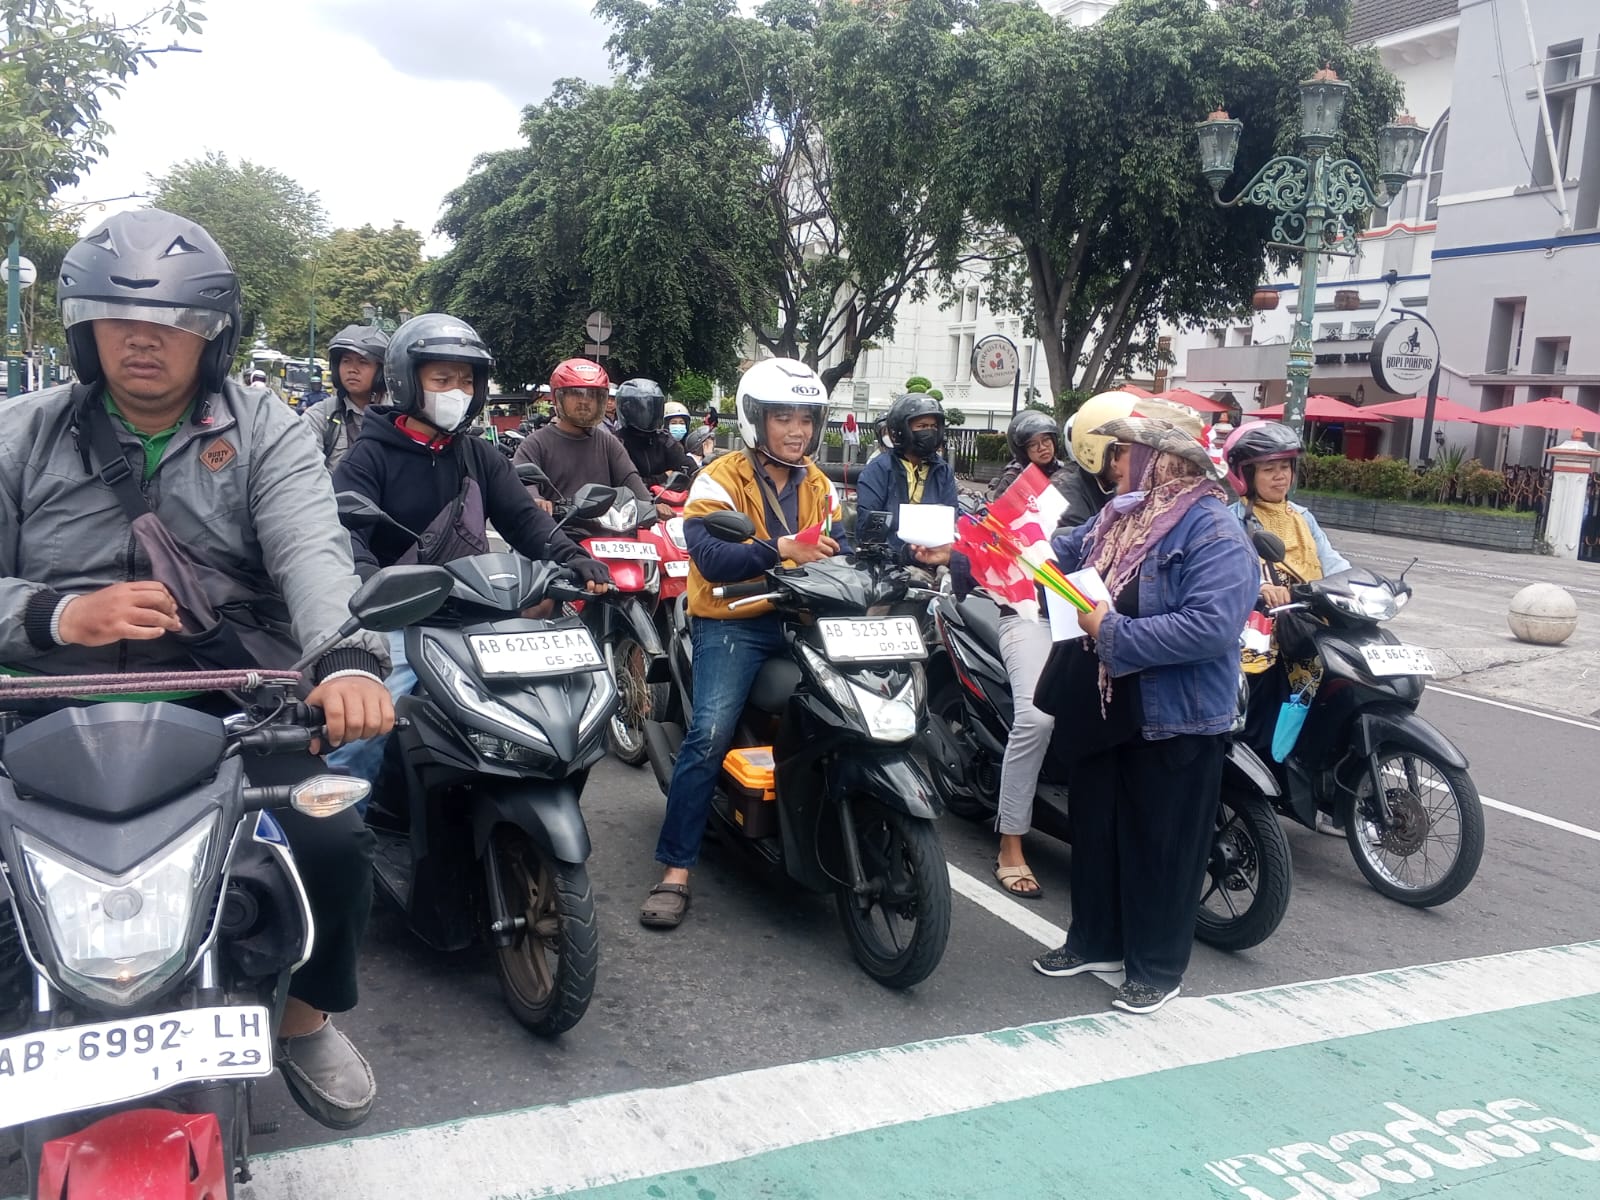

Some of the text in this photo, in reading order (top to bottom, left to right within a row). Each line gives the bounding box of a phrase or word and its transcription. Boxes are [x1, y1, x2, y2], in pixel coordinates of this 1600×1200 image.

[1386, 356, 1432, 370] KOPI PAKPOS
[613, 544, 636, 553] 2951
[643, 546, 655, 554] KL
[826, 622, 913, 637] AB 5253 FY
[478, 639, 501, 654] AB
[554, 633, 588, 649] EAA
[1367, 649, 1380, 660] AB
[0, 1013, 260, 1078] AB 6992 LH
